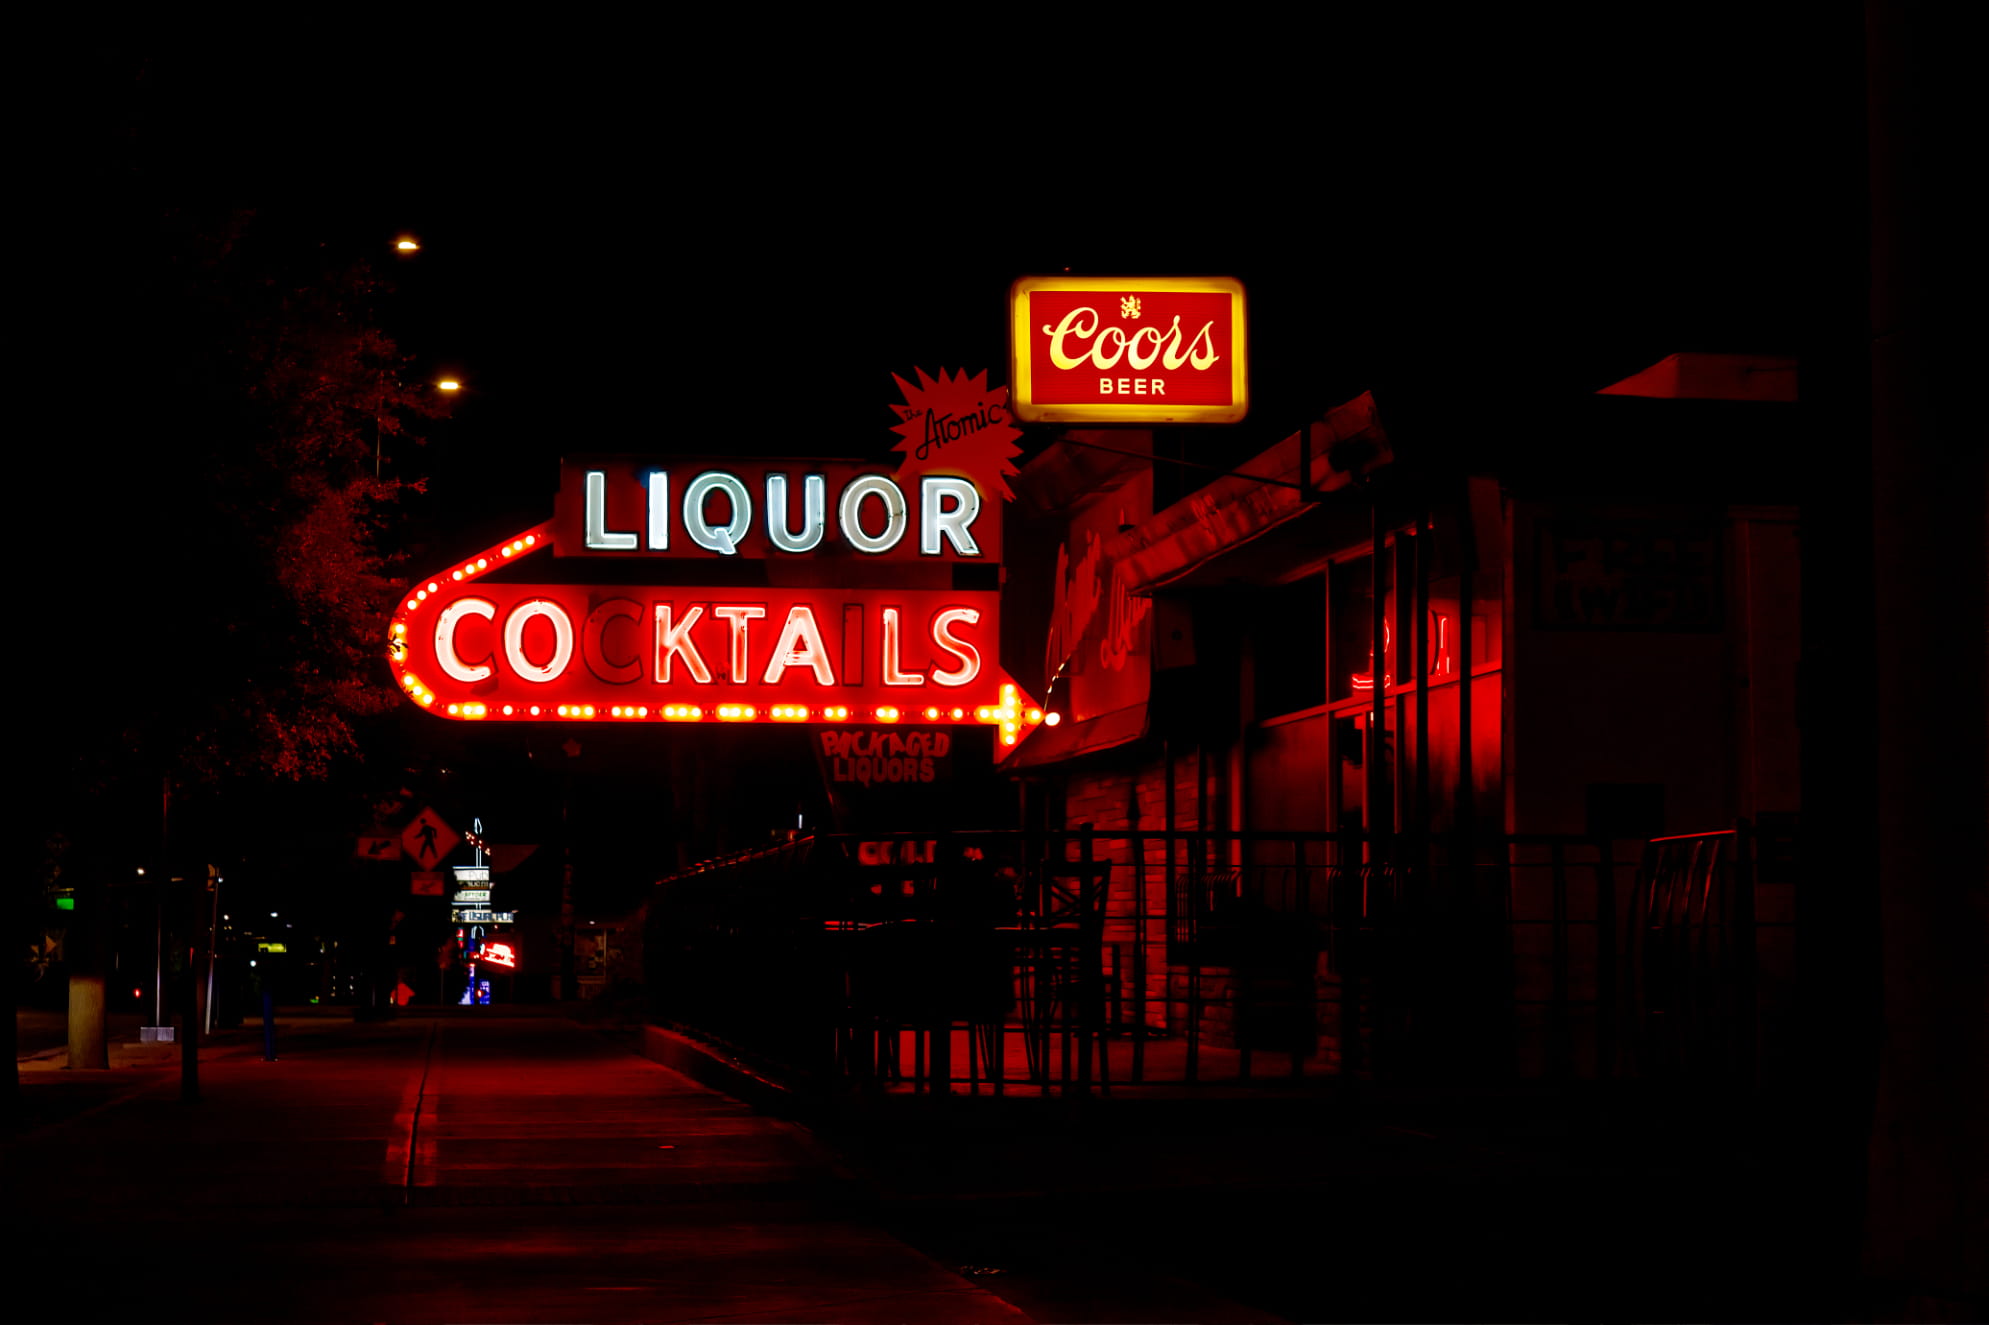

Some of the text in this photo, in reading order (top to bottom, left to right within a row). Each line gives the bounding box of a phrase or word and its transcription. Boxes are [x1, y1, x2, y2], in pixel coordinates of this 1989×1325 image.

[1042, 306, 1220, 371] Coors
[1100, 378, 1166, 395] BEER
[915, 402, 1008, 460] Atomic
[584, 470, 982, 556] LIQUOR
[433, 597, 983, 687] COCKTAILS
[820, 730, 951, 760] PACKAGED
[832, 757, 936, 789] LIQUORS
